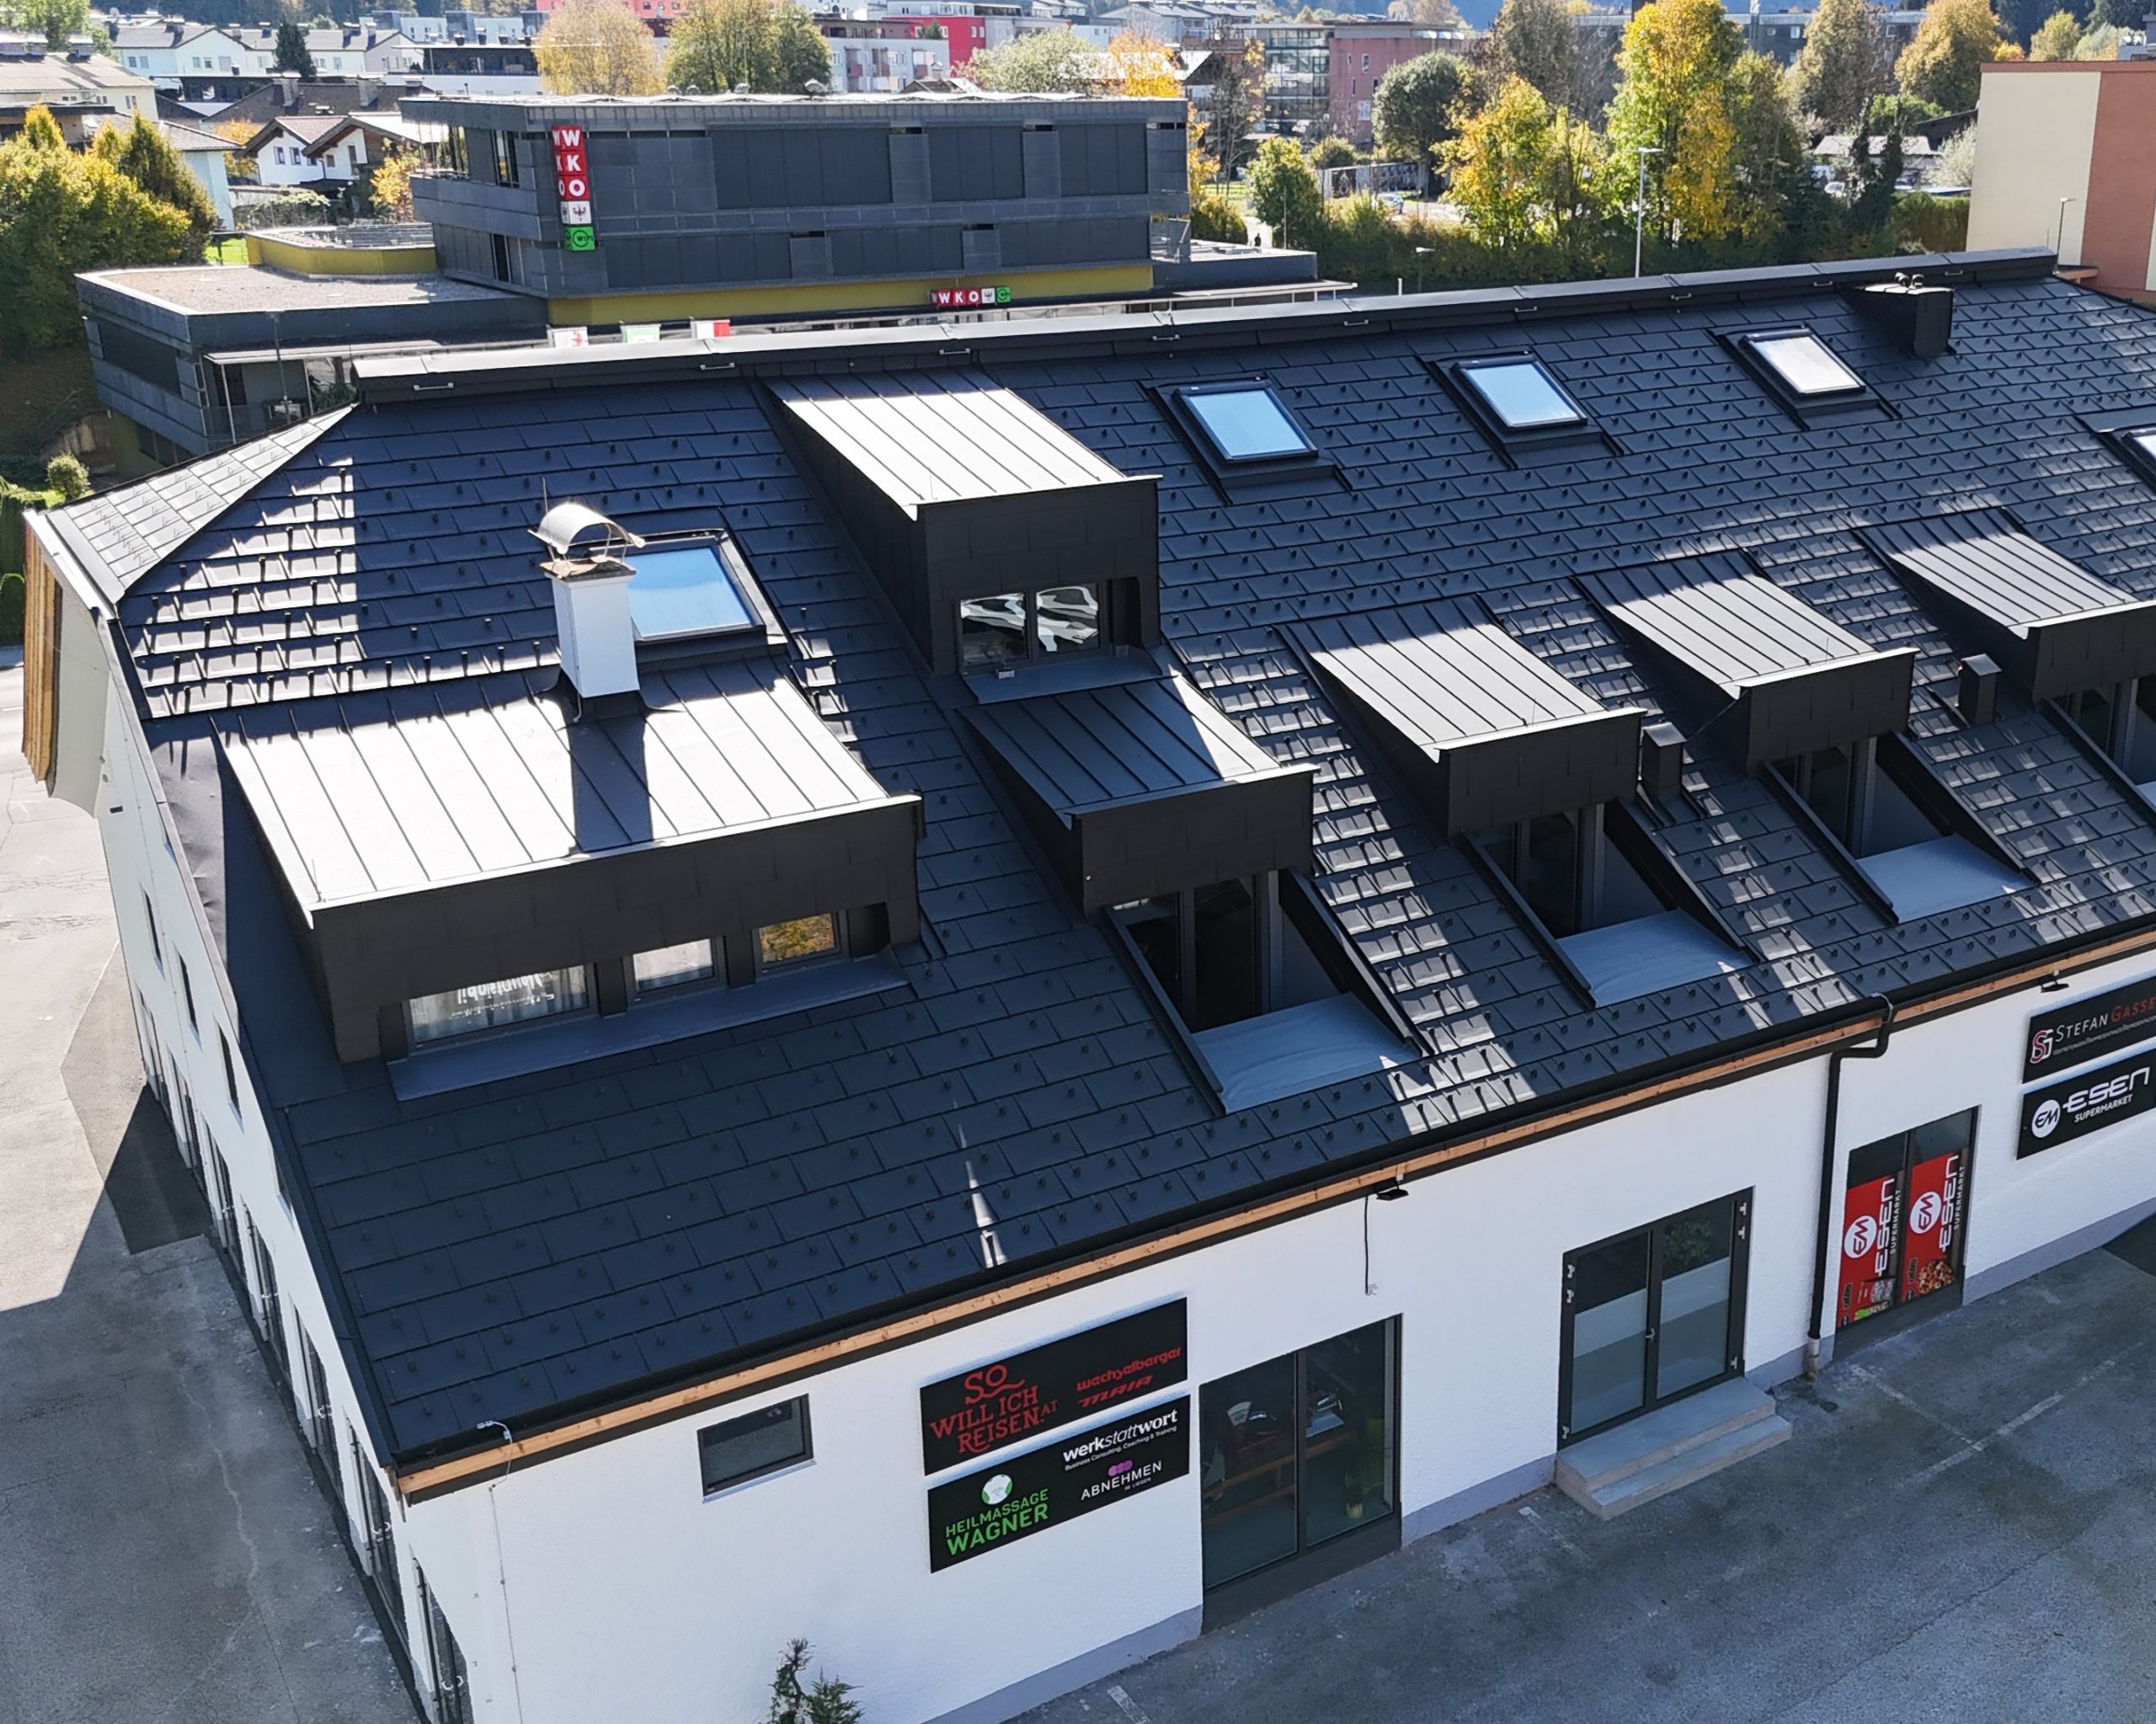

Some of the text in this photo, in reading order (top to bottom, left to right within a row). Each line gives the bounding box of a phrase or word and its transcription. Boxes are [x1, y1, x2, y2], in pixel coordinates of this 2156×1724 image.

[561, 129, 585, 197] WKO
[938, 291, 979, 304] WKO
[2055, 1012, 2109, 1043] STEFAN
[2035, 1108, 2057, 1129] EM
[2073, 1094, 2133, 1124] SUPERMARKET
[1918, 1194, 1934, 1231] EM
[1953, 1165, 1966, 1231] SUPERMARKT
[1854, 1218, 1870, 1255] EM
[1889, 1188, 1901, 1256] SUPERMARKT
[963, 1364, 1026, 1405] SO
[929, 1385, 1039, 1439] WILL ICH
[1063, 1409, 1178, 1463] werkstattwort
[1065, 1458, 1091, 1472] Business
[1123, 1435, 1150, 1449] Coaching
[1081, 1460, 1162, 1501] ABNEHMEN
[945, 1488, 1049, 1538] HEILMASSAGE
[946, 1503, 1049, 1556] WAGNER
